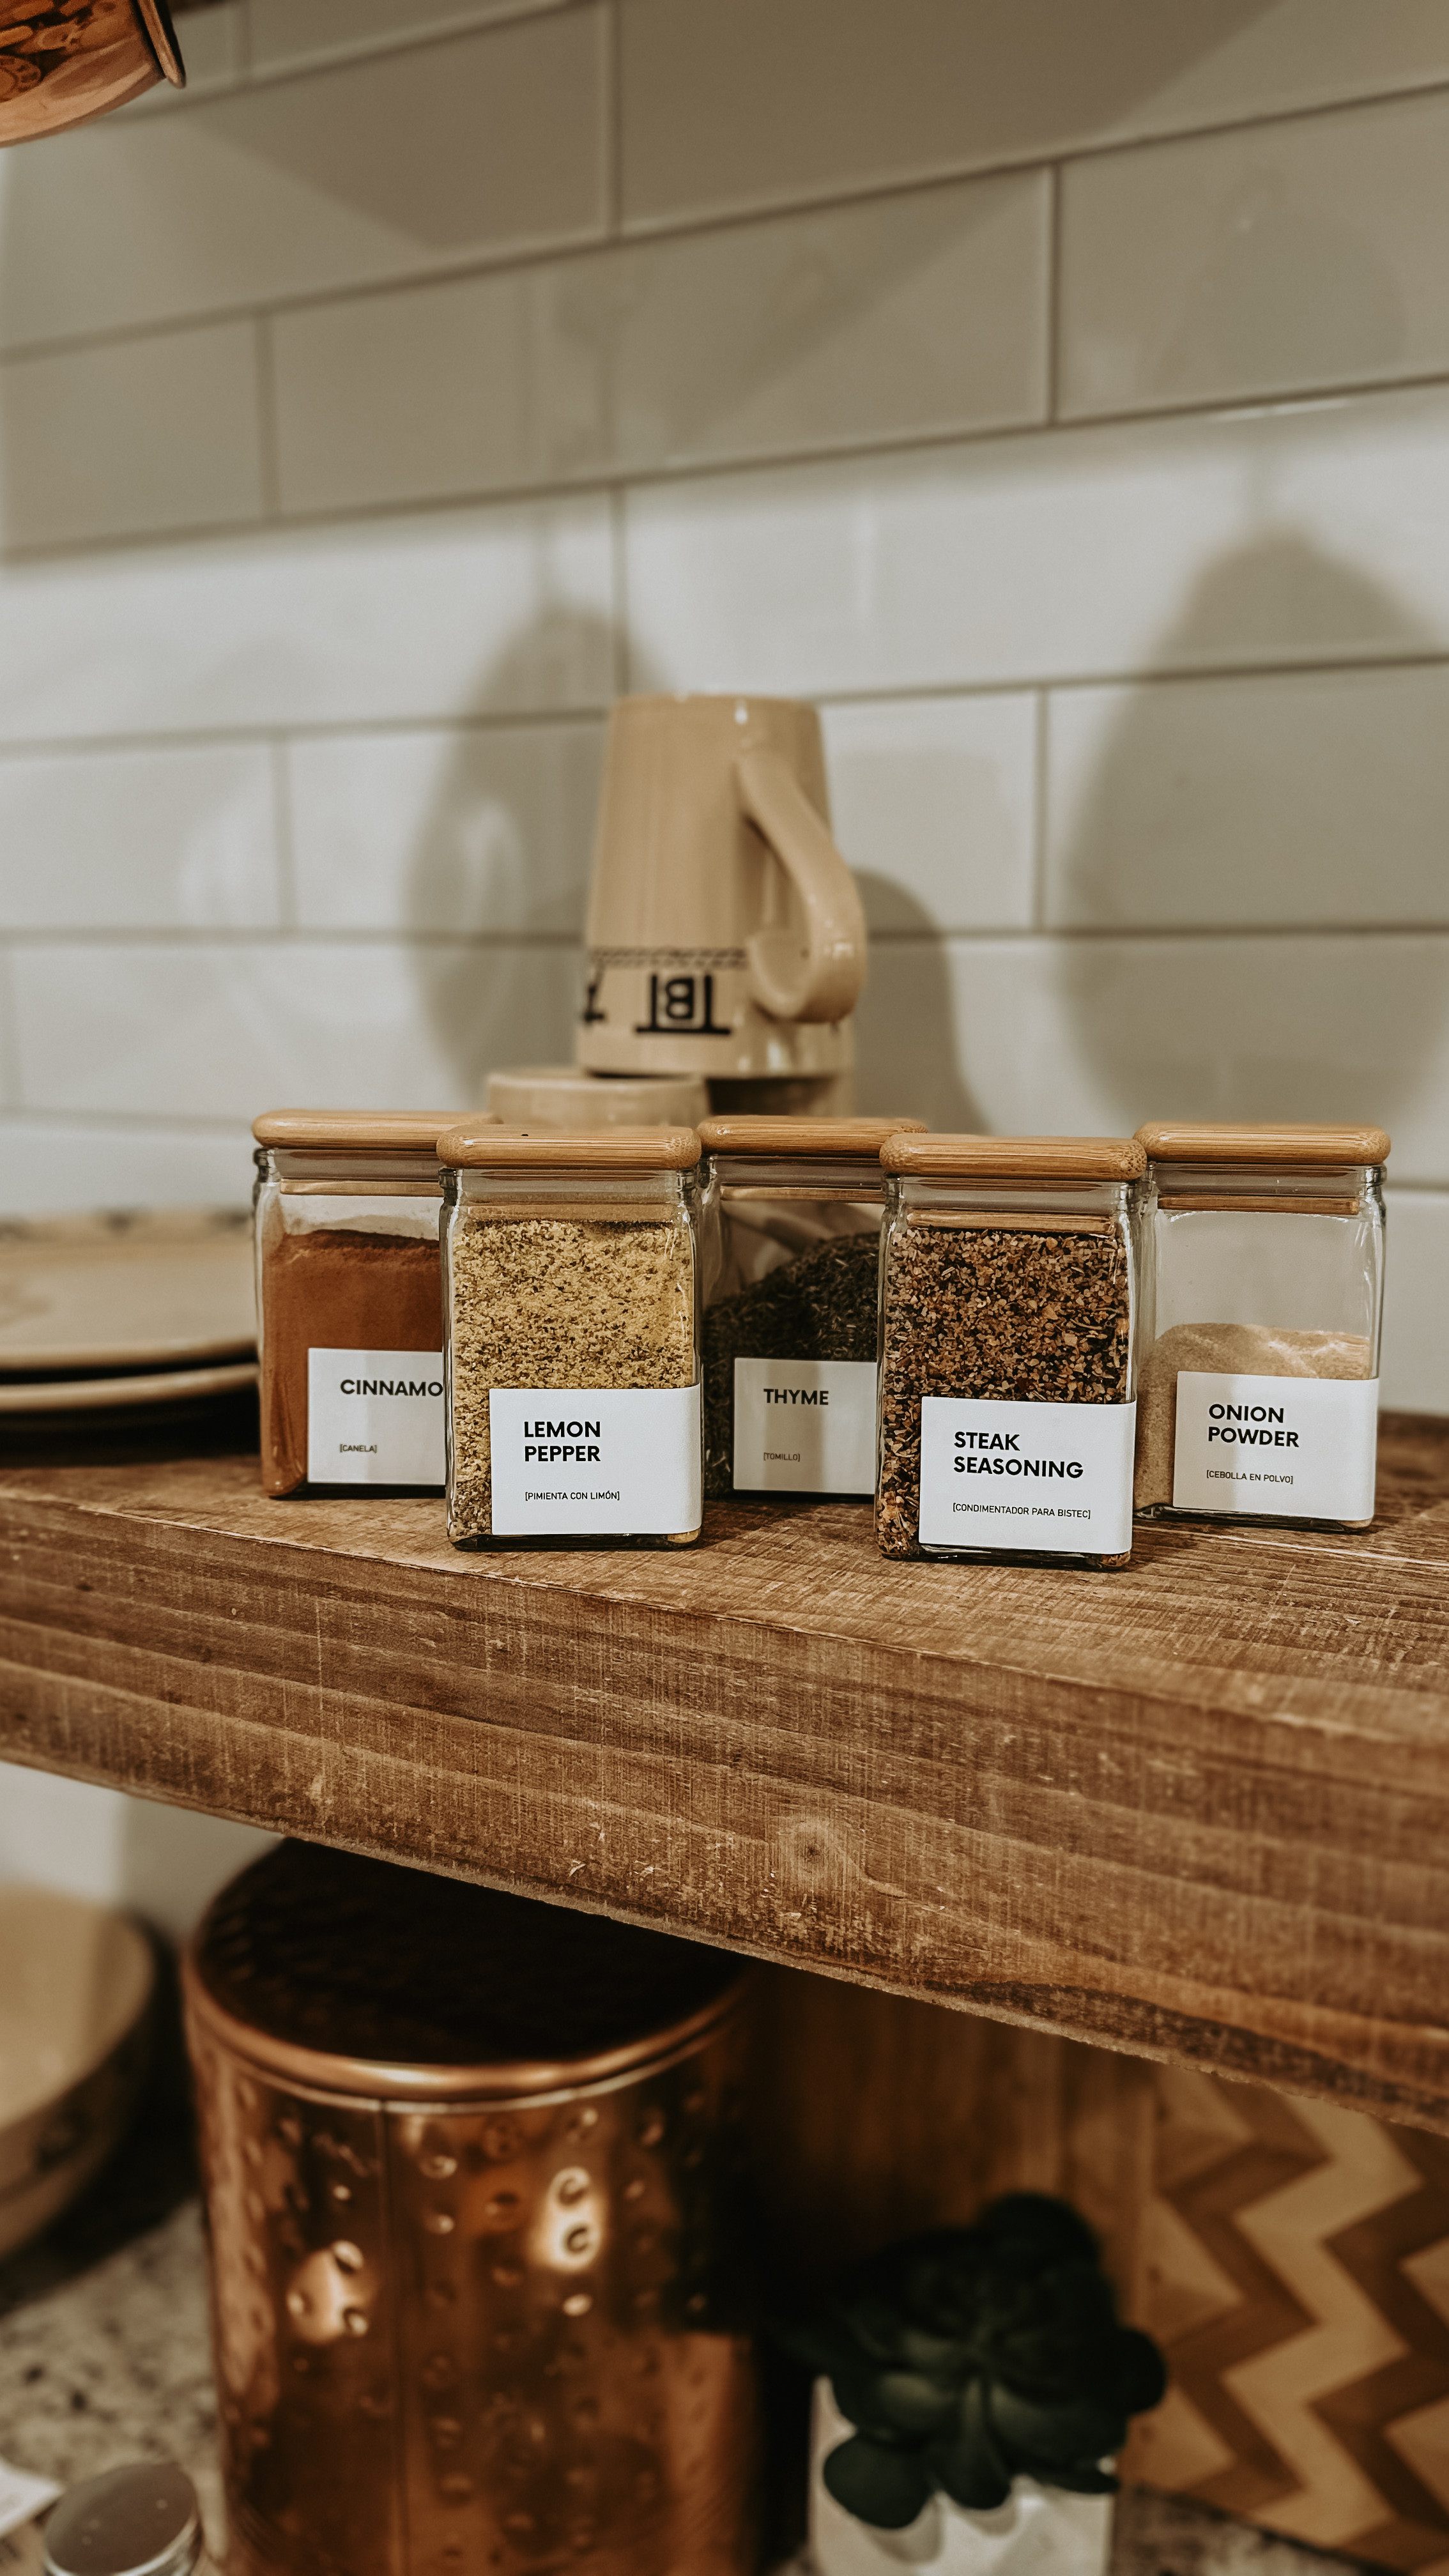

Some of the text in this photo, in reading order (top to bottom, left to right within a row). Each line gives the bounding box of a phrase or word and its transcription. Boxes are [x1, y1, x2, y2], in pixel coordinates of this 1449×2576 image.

[340, 1379, 444, 1397] CINNAMO
[763, 1388, 829, 1406] THYME
[1208, 1404, 1284, 1423] ONION
[524, 1421, 601, 1438] LEMON
[1208, 1426, 1300, 1448] POWDER
[340, 1444, 377, 1454] [CANELA]
[953, 1431, 1020, 1452] STEAK
[525, 1445, 601, 1462] PEPPER
[763, 1452, 801, 1462] [TOMILLO]
[953, 1456, 1084, 1479] SEASONING
[1206, 1469, 1247, 1480] [CEBOLLA
[1263, 1474, 1293, 1485] POLVO]
[525, 1490, 620, 1501] [PIMIENTA CON LIMÓN]
[953, 1502, 1091, 1520] [CONDIMENTADOR PARA BISTEC]
